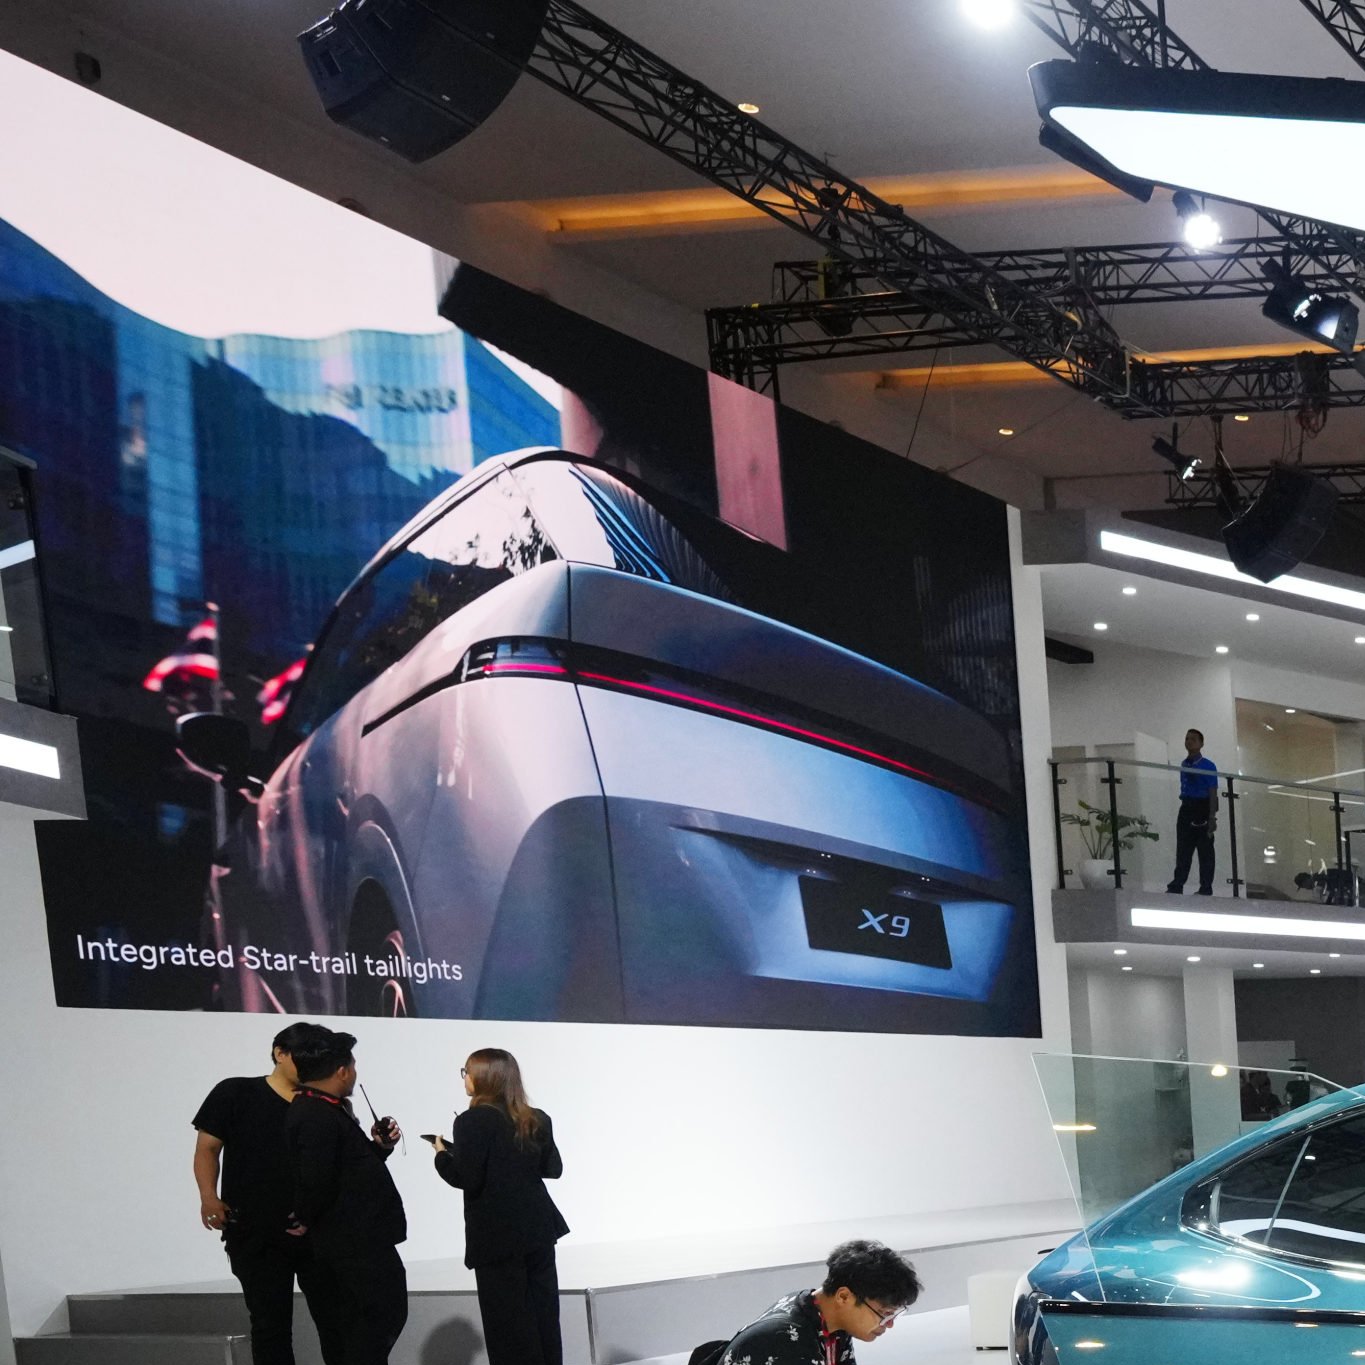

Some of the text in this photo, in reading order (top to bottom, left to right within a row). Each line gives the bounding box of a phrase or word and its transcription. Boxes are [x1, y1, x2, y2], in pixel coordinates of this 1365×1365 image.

[857, 908, 910, 937] X9
[76, 934, 463, 985] Integrated Star-trail taillights
